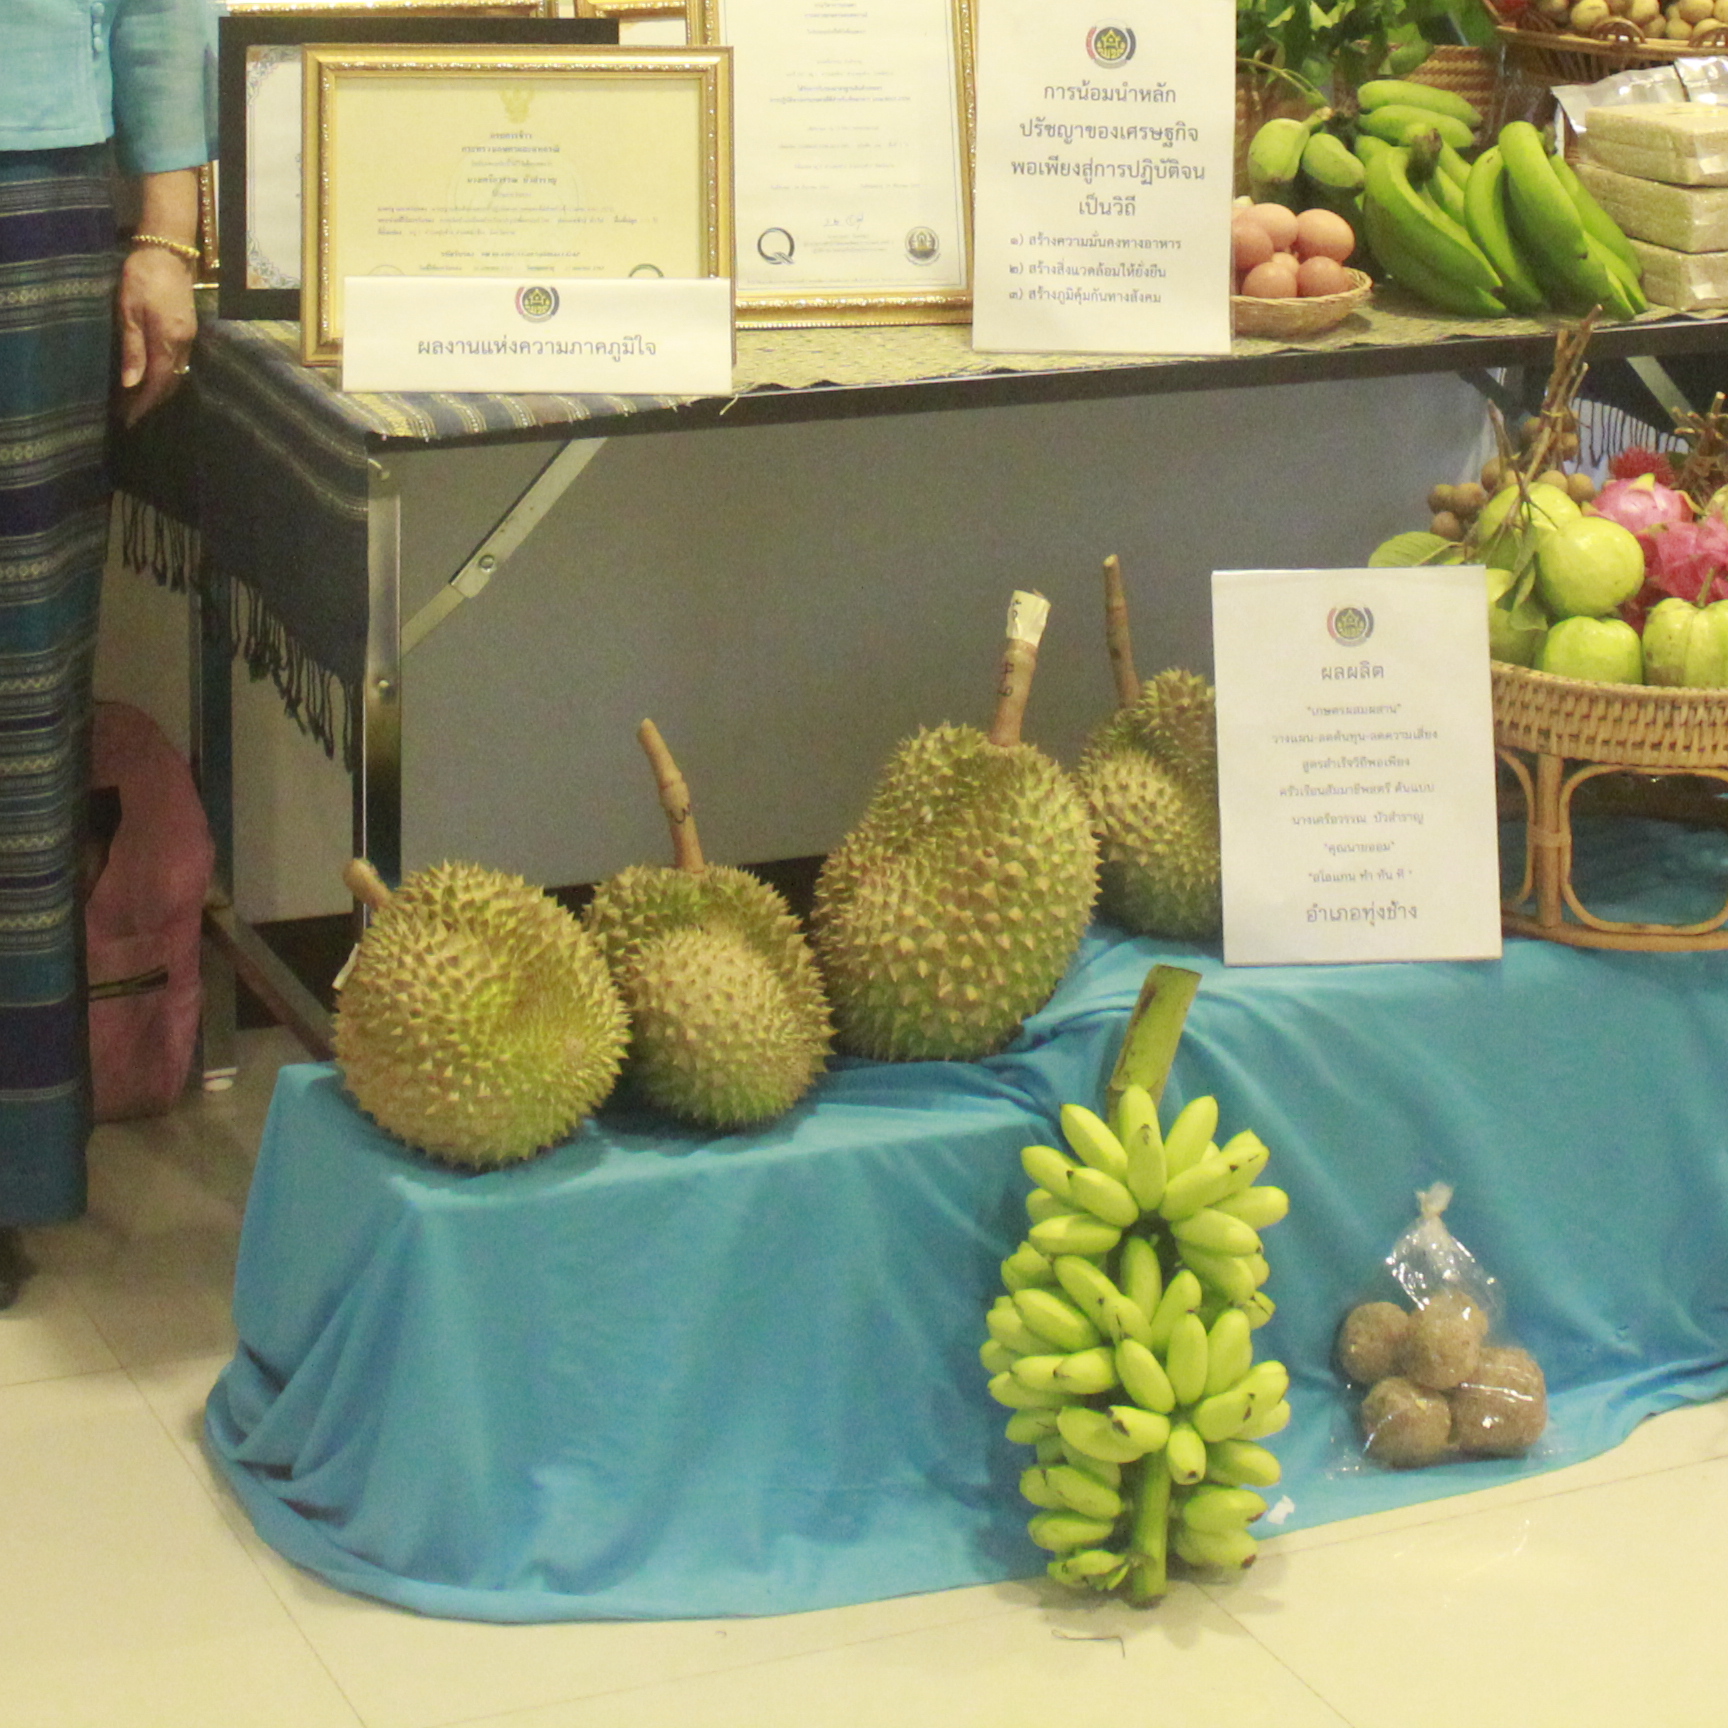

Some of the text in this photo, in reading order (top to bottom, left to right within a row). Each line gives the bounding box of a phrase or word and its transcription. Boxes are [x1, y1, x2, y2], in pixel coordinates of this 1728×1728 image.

[1042, 80, 1176, 103] การน้อมนำหลัก
[1019, 118, 1199, 148] ปรัชญาของเศรษฐกิจ
[1011, 156, 1206, 185] พอเพียงสู่การปฏิบัติจน
[1078, 194, 1137, 217] เป็นวิถี
[1028, 230, 1182, 250] สร้างความมั่นคงทางอาหาร
[1028, 259, 1167, 279] สร้างสิ่งแวดล้อมให้ยั่งยืน
[1028, 285, 1162, 306] สร้างภูมิคุ้มกันทางสังคม
[417, 334, 657, 362] ผลงานแห่งความภาคภูมิใจ
[1320, 660, 1385, 681] ผลผลิต
[1306, 900, 1418, 926] อำเภอทุ่งช้าง
